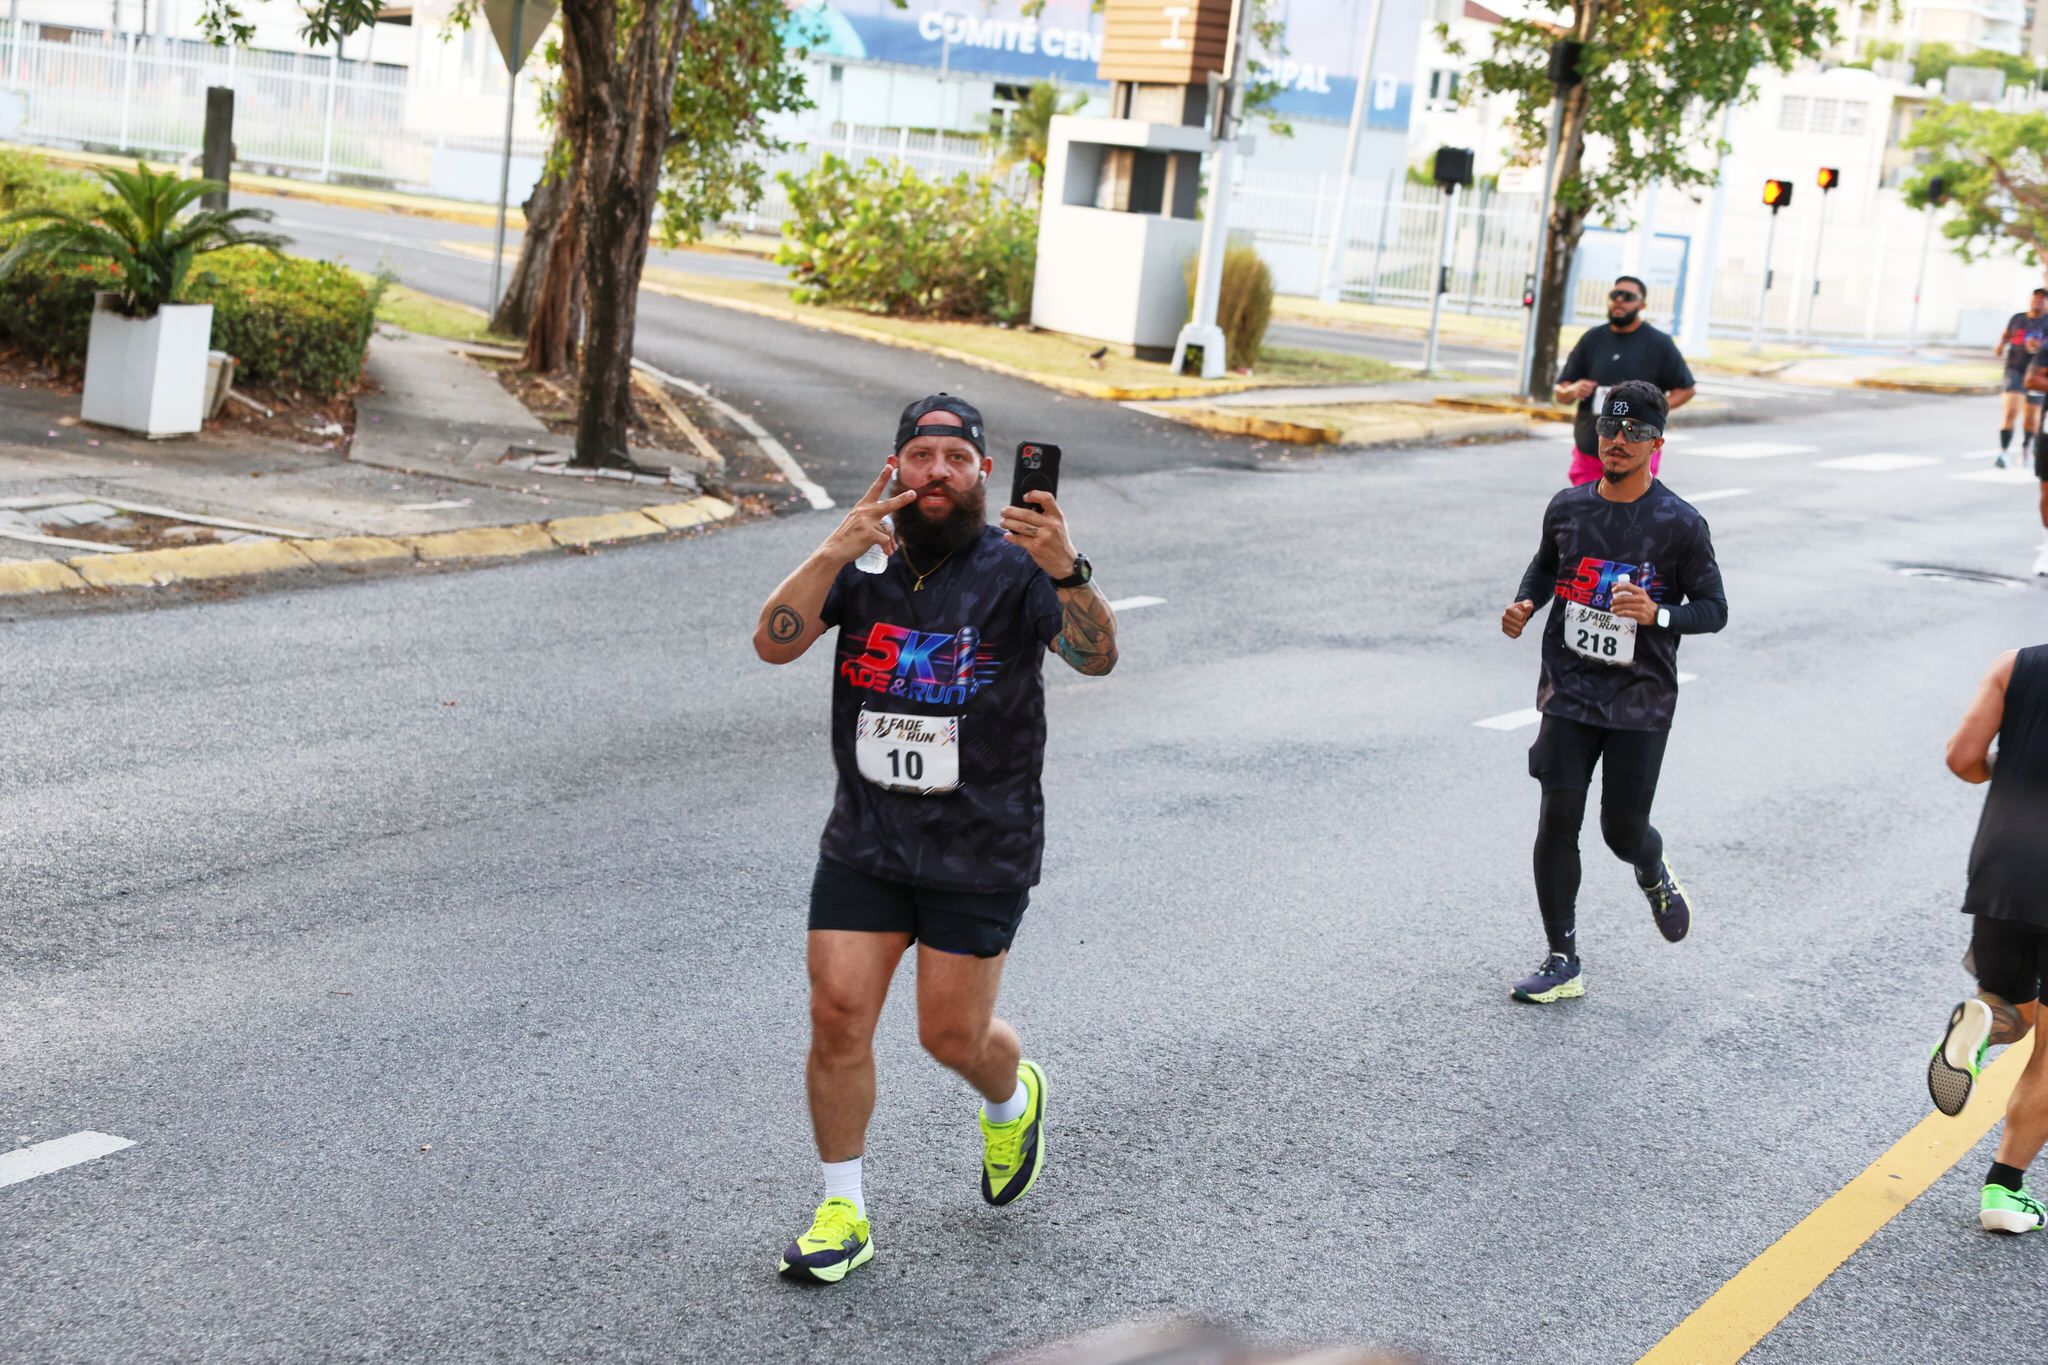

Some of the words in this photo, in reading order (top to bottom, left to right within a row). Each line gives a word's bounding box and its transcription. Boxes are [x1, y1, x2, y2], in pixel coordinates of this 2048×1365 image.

[918, 10, 1037, 54] COMITÉ
[1041, 27, 1103, 62] CEN
[1571, 557, 1638, 594] 5K
[1555, 585, 1594, 605] FADE
[1592, 594, 1605, 608] &
[1588, 610, 1613, 623] FADE
[1599, 621, 1621, 632] RUN
[856, 622, 956, 684] 5K
[1576, 629, 1618, 656] 218
[841, 660, 892, 693] ADE
[889, 678, 908, 697] &
[889, 718, 924, 732] FADE
[906, 732, 936, 743] RUN
[887, 748, 924, 781] 10
